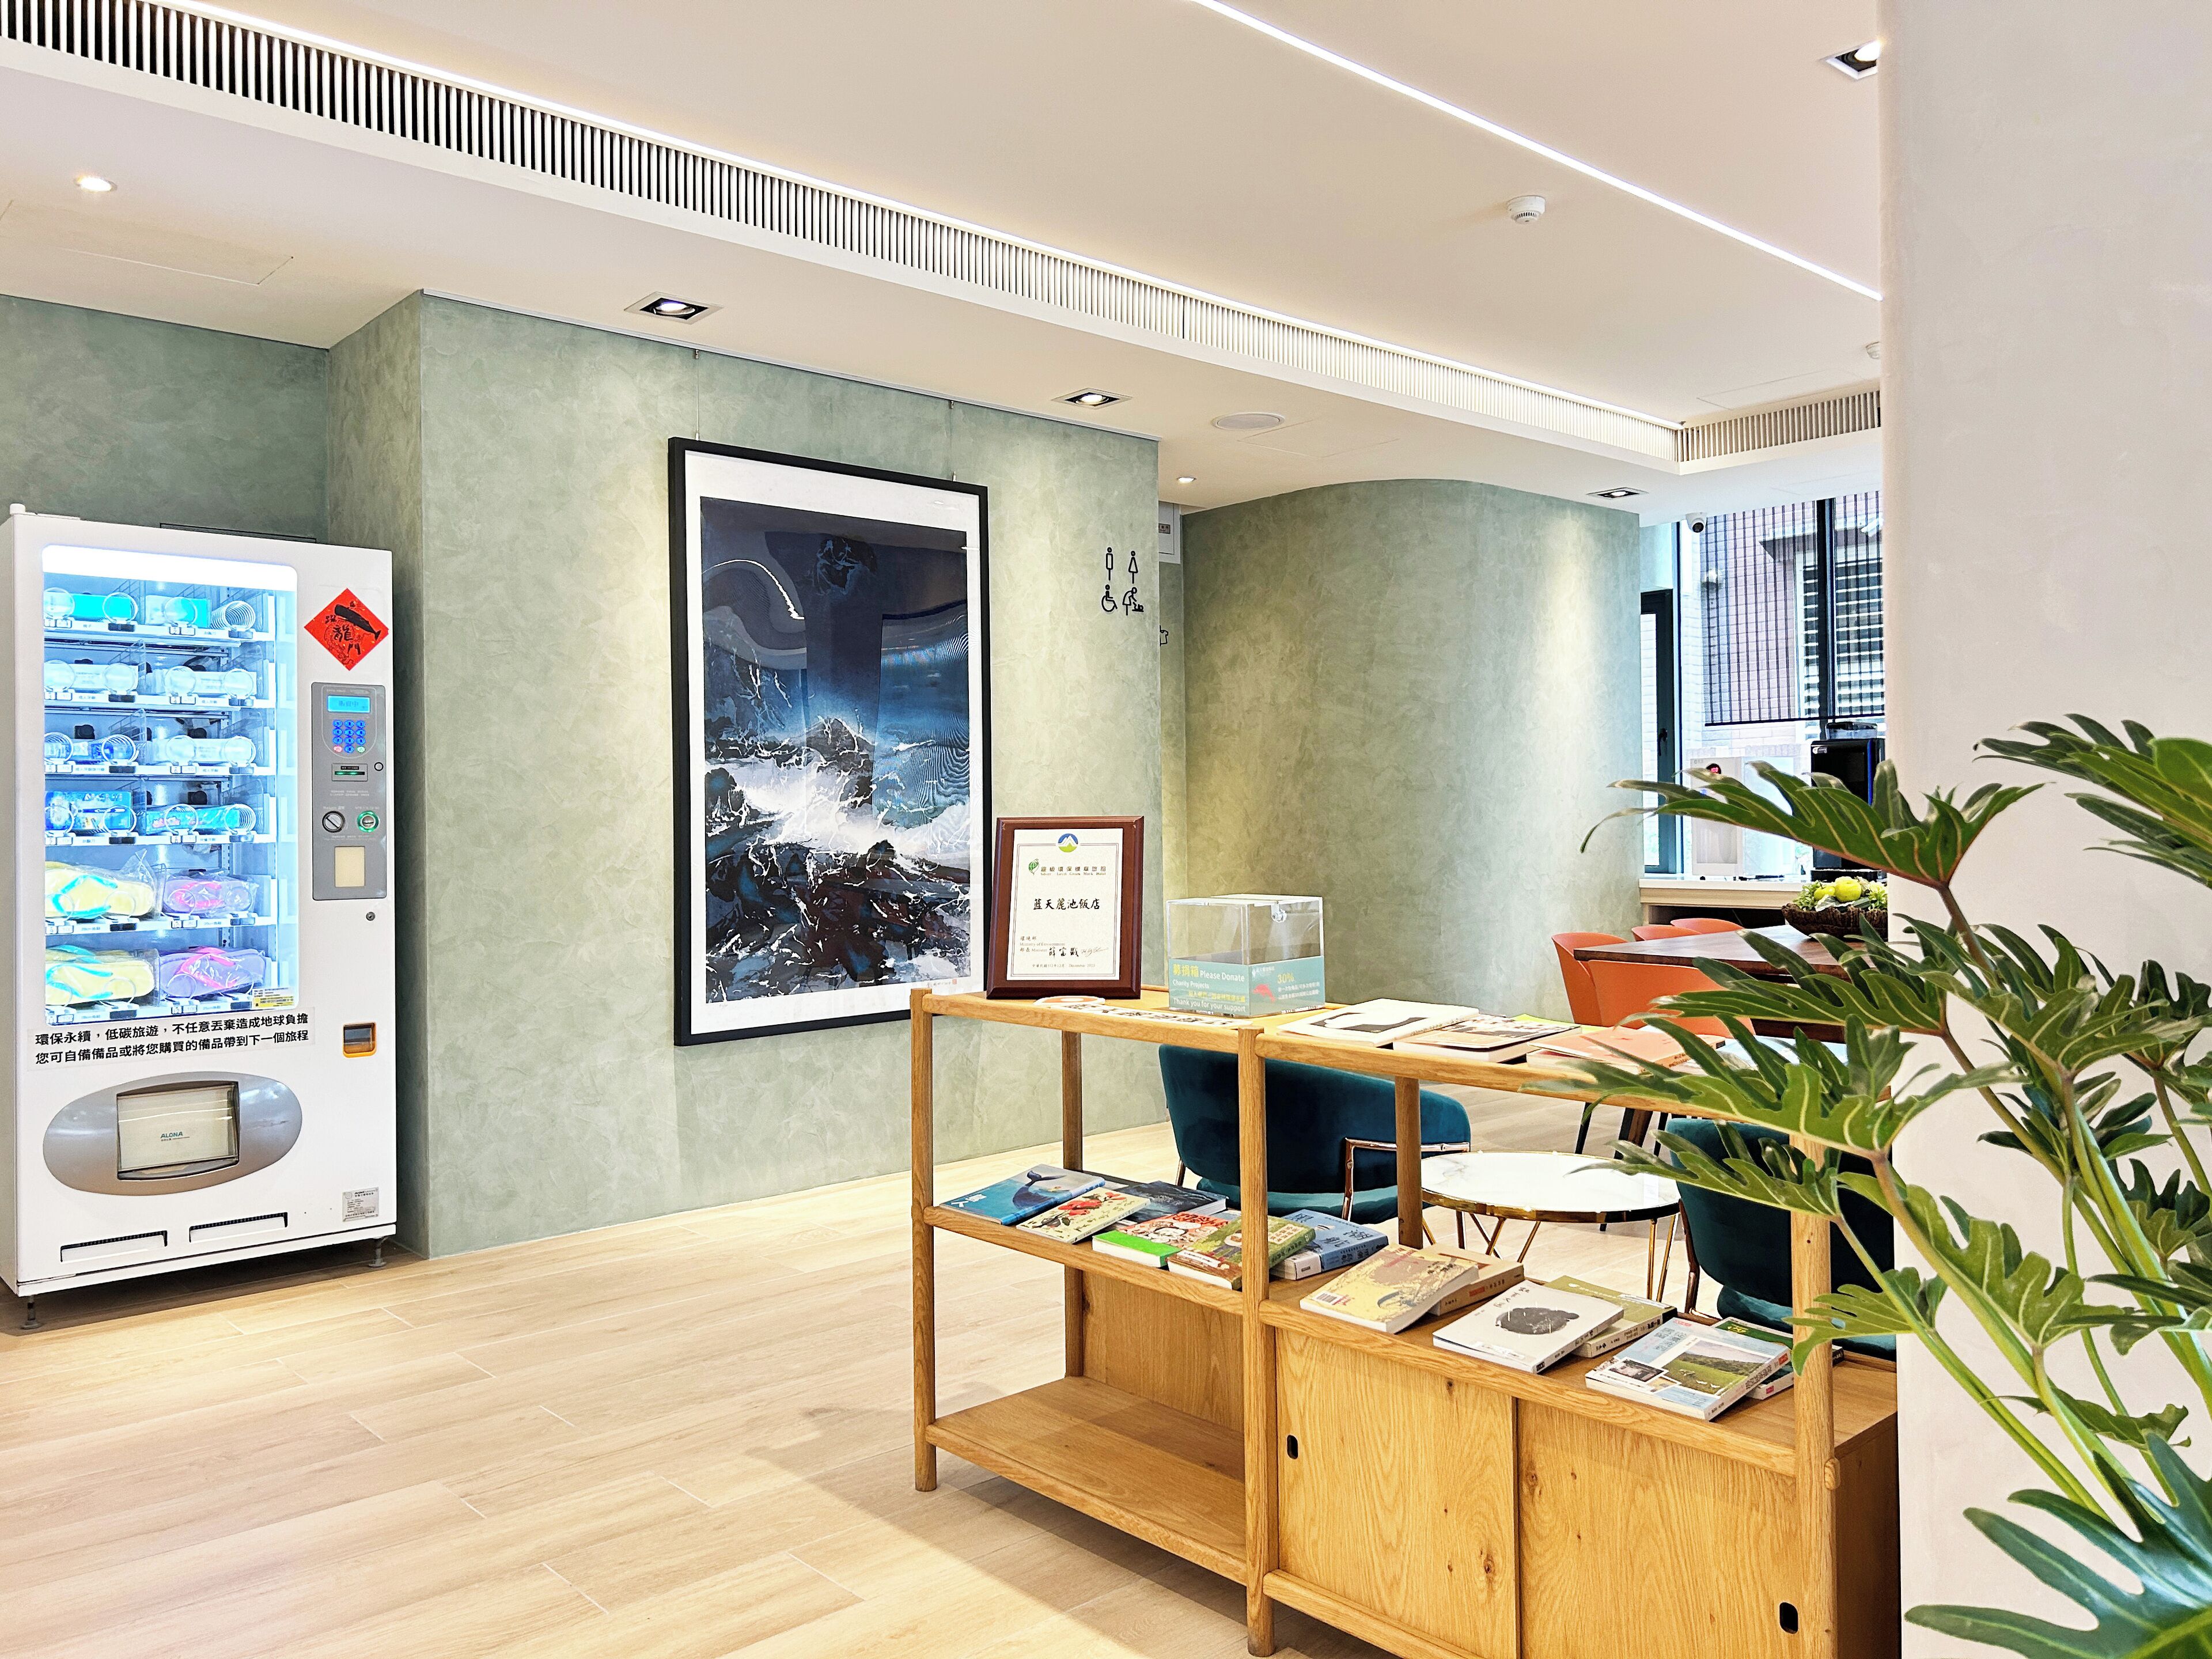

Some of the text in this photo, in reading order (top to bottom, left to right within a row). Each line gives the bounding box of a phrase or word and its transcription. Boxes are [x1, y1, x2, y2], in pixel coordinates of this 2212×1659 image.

[1200, 970, 1221, 979] Please
[1221, 972, 1245, 982] Donate
[1172, 979, 1210, 990] Charity Projects
[1173, 997, 1190, 1005] Thank
[1224, 1004, 1246, 1013] support
[35, 1030, 309, 1065] 您可自備備品或將您購買的備品帶到下一個旅程
